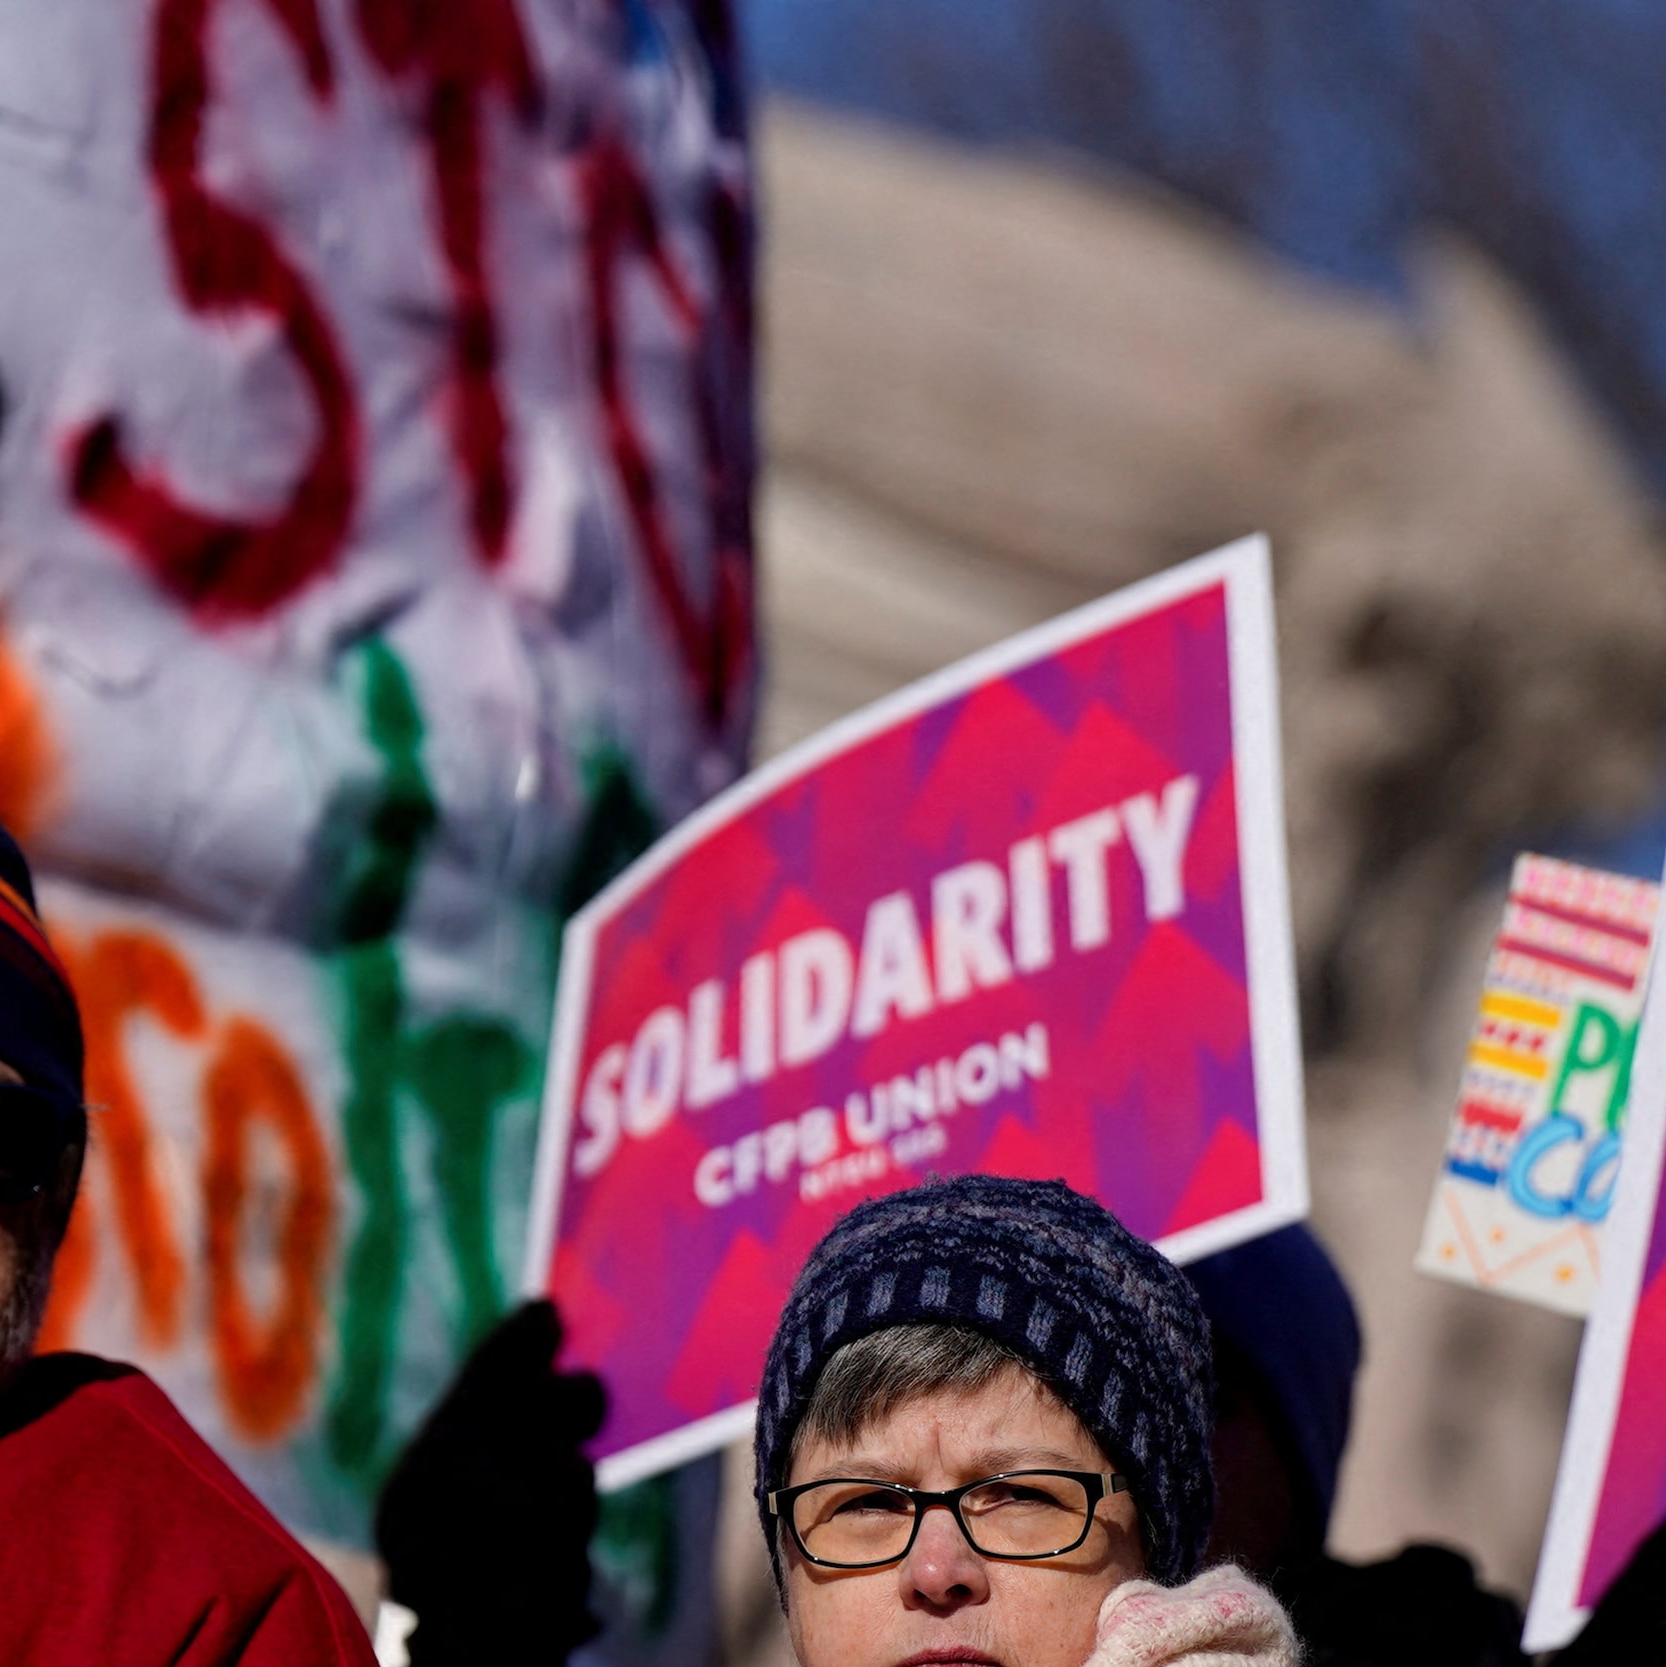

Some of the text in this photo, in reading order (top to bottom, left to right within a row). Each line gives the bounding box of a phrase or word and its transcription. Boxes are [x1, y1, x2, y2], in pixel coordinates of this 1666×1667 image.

[573, 772, 1199, 1178] SOLIDARITY
[693, 1104, 839, 1208] CFPB
[843, 1020, 1050, 1147] UNION
